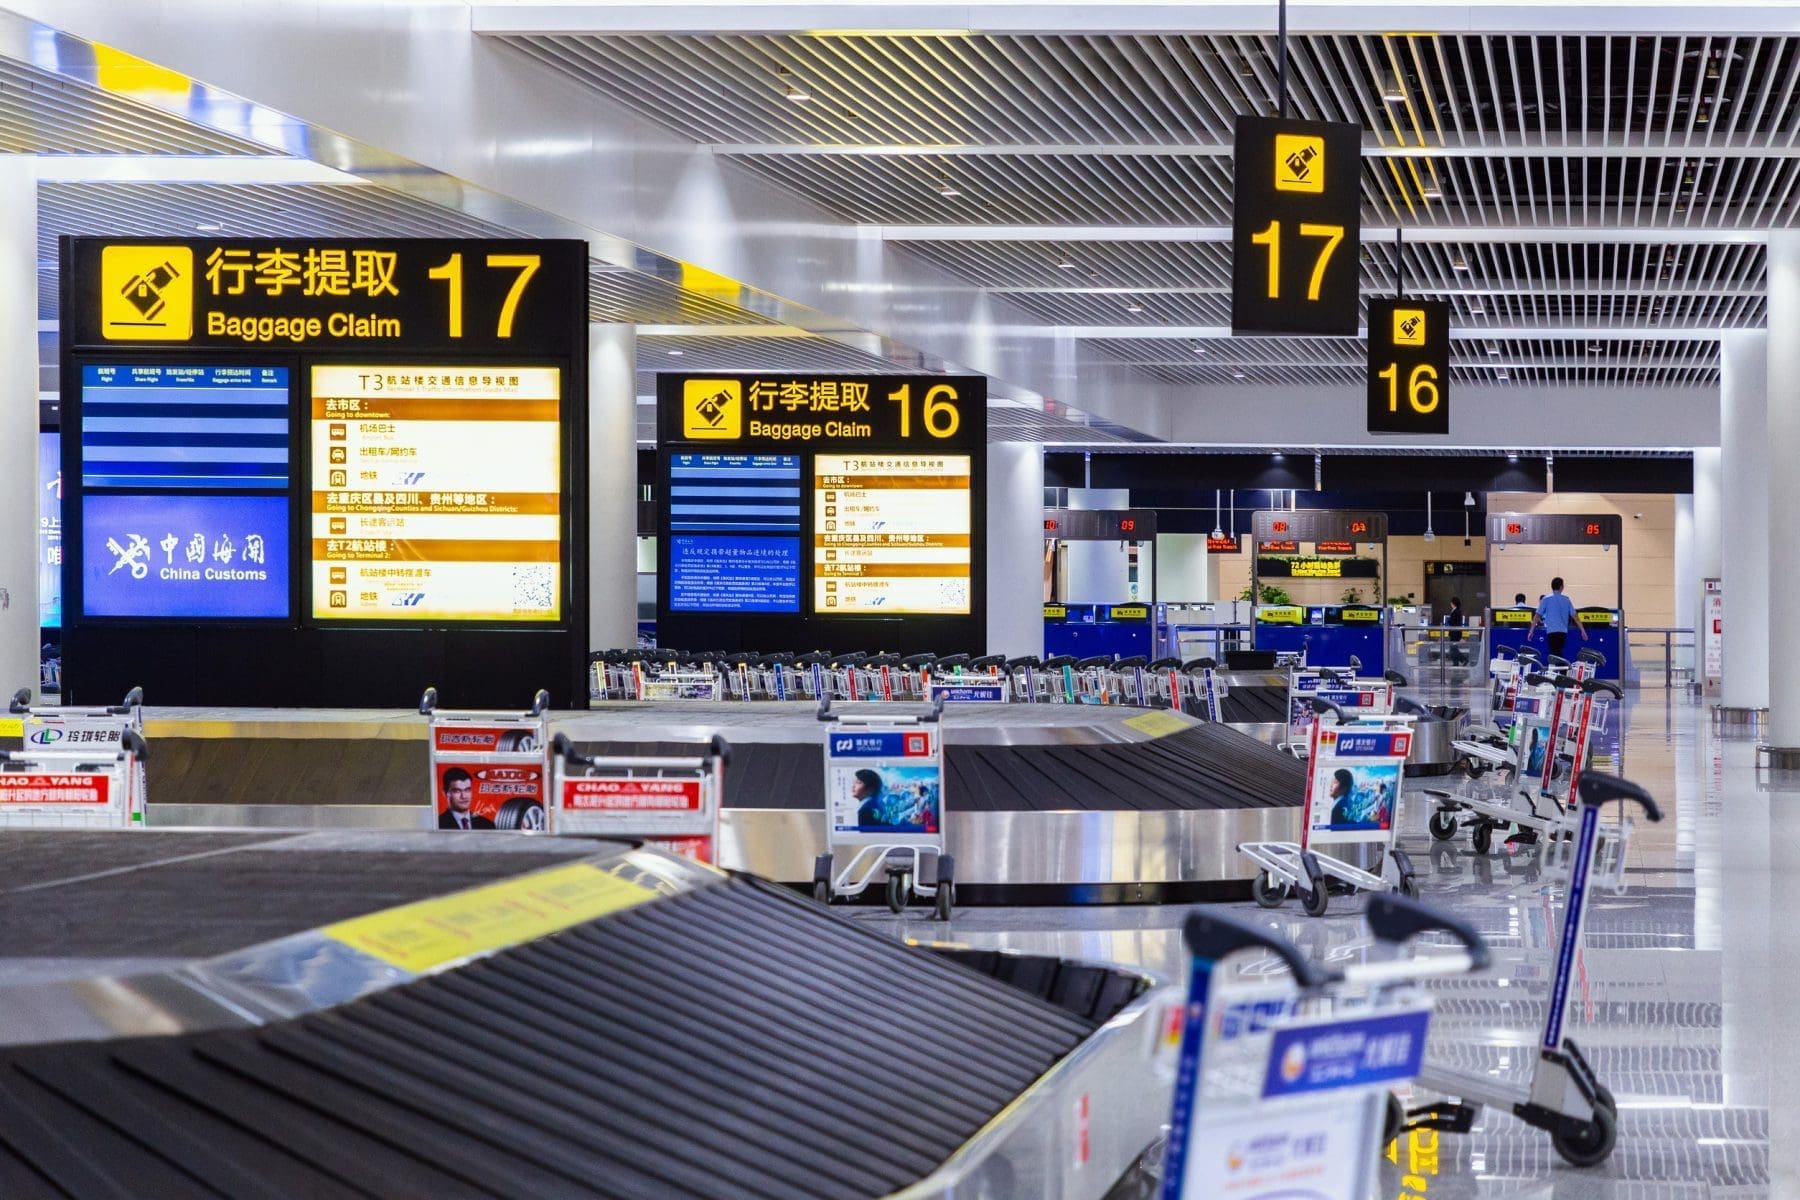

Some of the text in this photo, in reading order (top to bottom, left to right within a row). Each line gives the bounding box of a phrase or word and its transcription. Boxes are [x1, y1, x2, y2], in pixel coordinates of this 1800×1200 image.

[206, 247, 399, 297] 行李提取
[1252, 220, 1344, 301] 17
[428, 254, 541, 338] 17
[207, 312, 401, 342] Baggage Claim
[749, 381, 871, 412] 行李提取
[1379, 363, 1438, 413] 16
[887, 384, 960, 439] 16
[360, 424, 396, 433] 机场巴士
[750, 421, 871, 440] Baggage Claim
[1121, 520, 1134, 530] 09
[160, 568, 267, 580] China Customs
[67, 731, 120, 742] 玲珑轮胎
[51, 777, 93, 786] YANG
[576, 783, 684, 793] CHAO YANG
